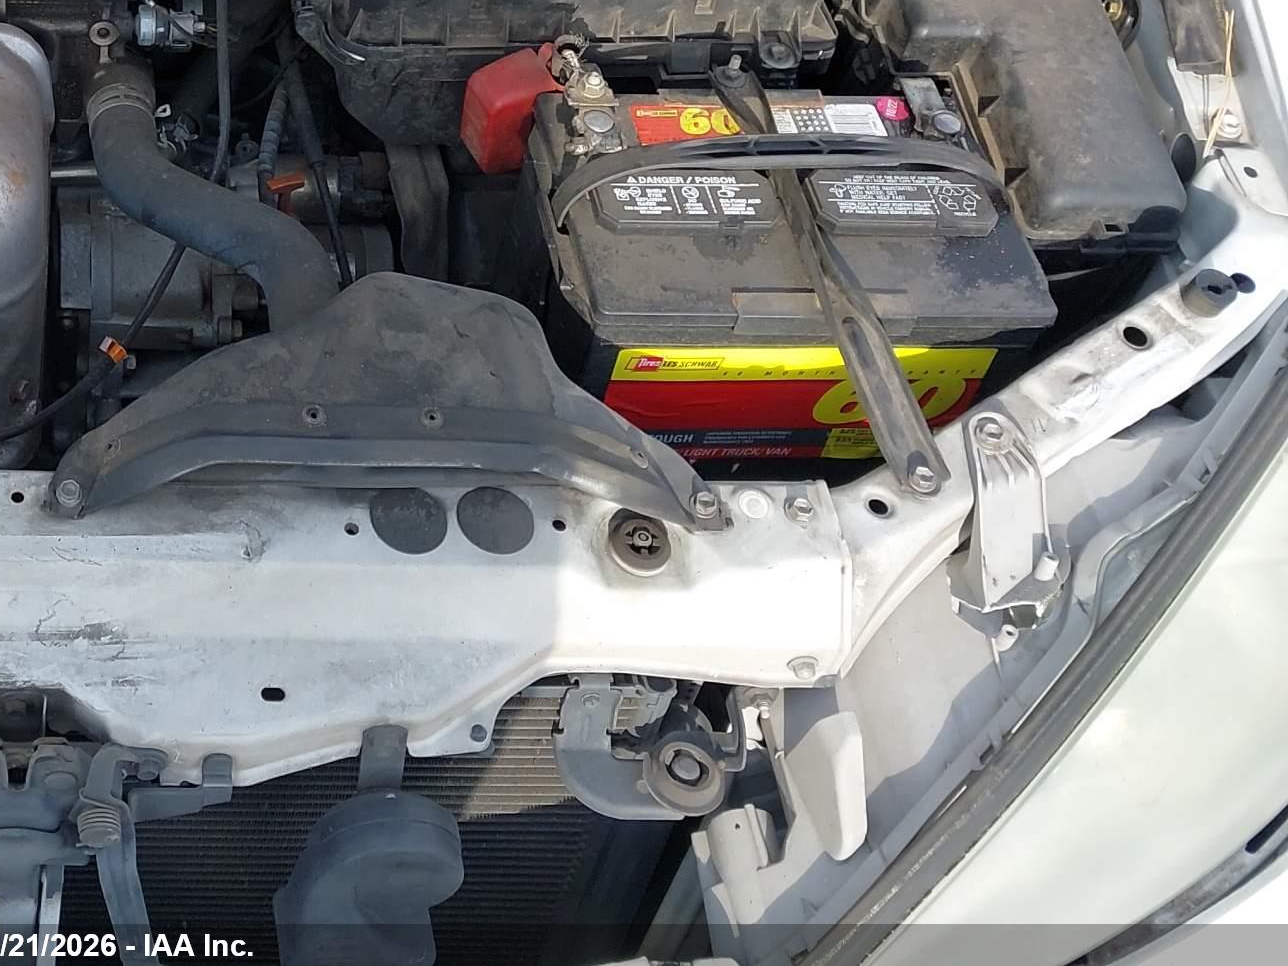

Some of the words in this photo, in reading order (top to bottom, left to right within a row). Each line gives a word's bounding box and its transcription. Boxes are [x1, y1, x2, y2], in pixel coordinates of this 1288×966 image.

[679, 107, 741, 135] 60
[638, 176, 684, 184] DANGER
[694, 176, 737, 184] POISON
[679, 360, 718, 368] SCHWAB
